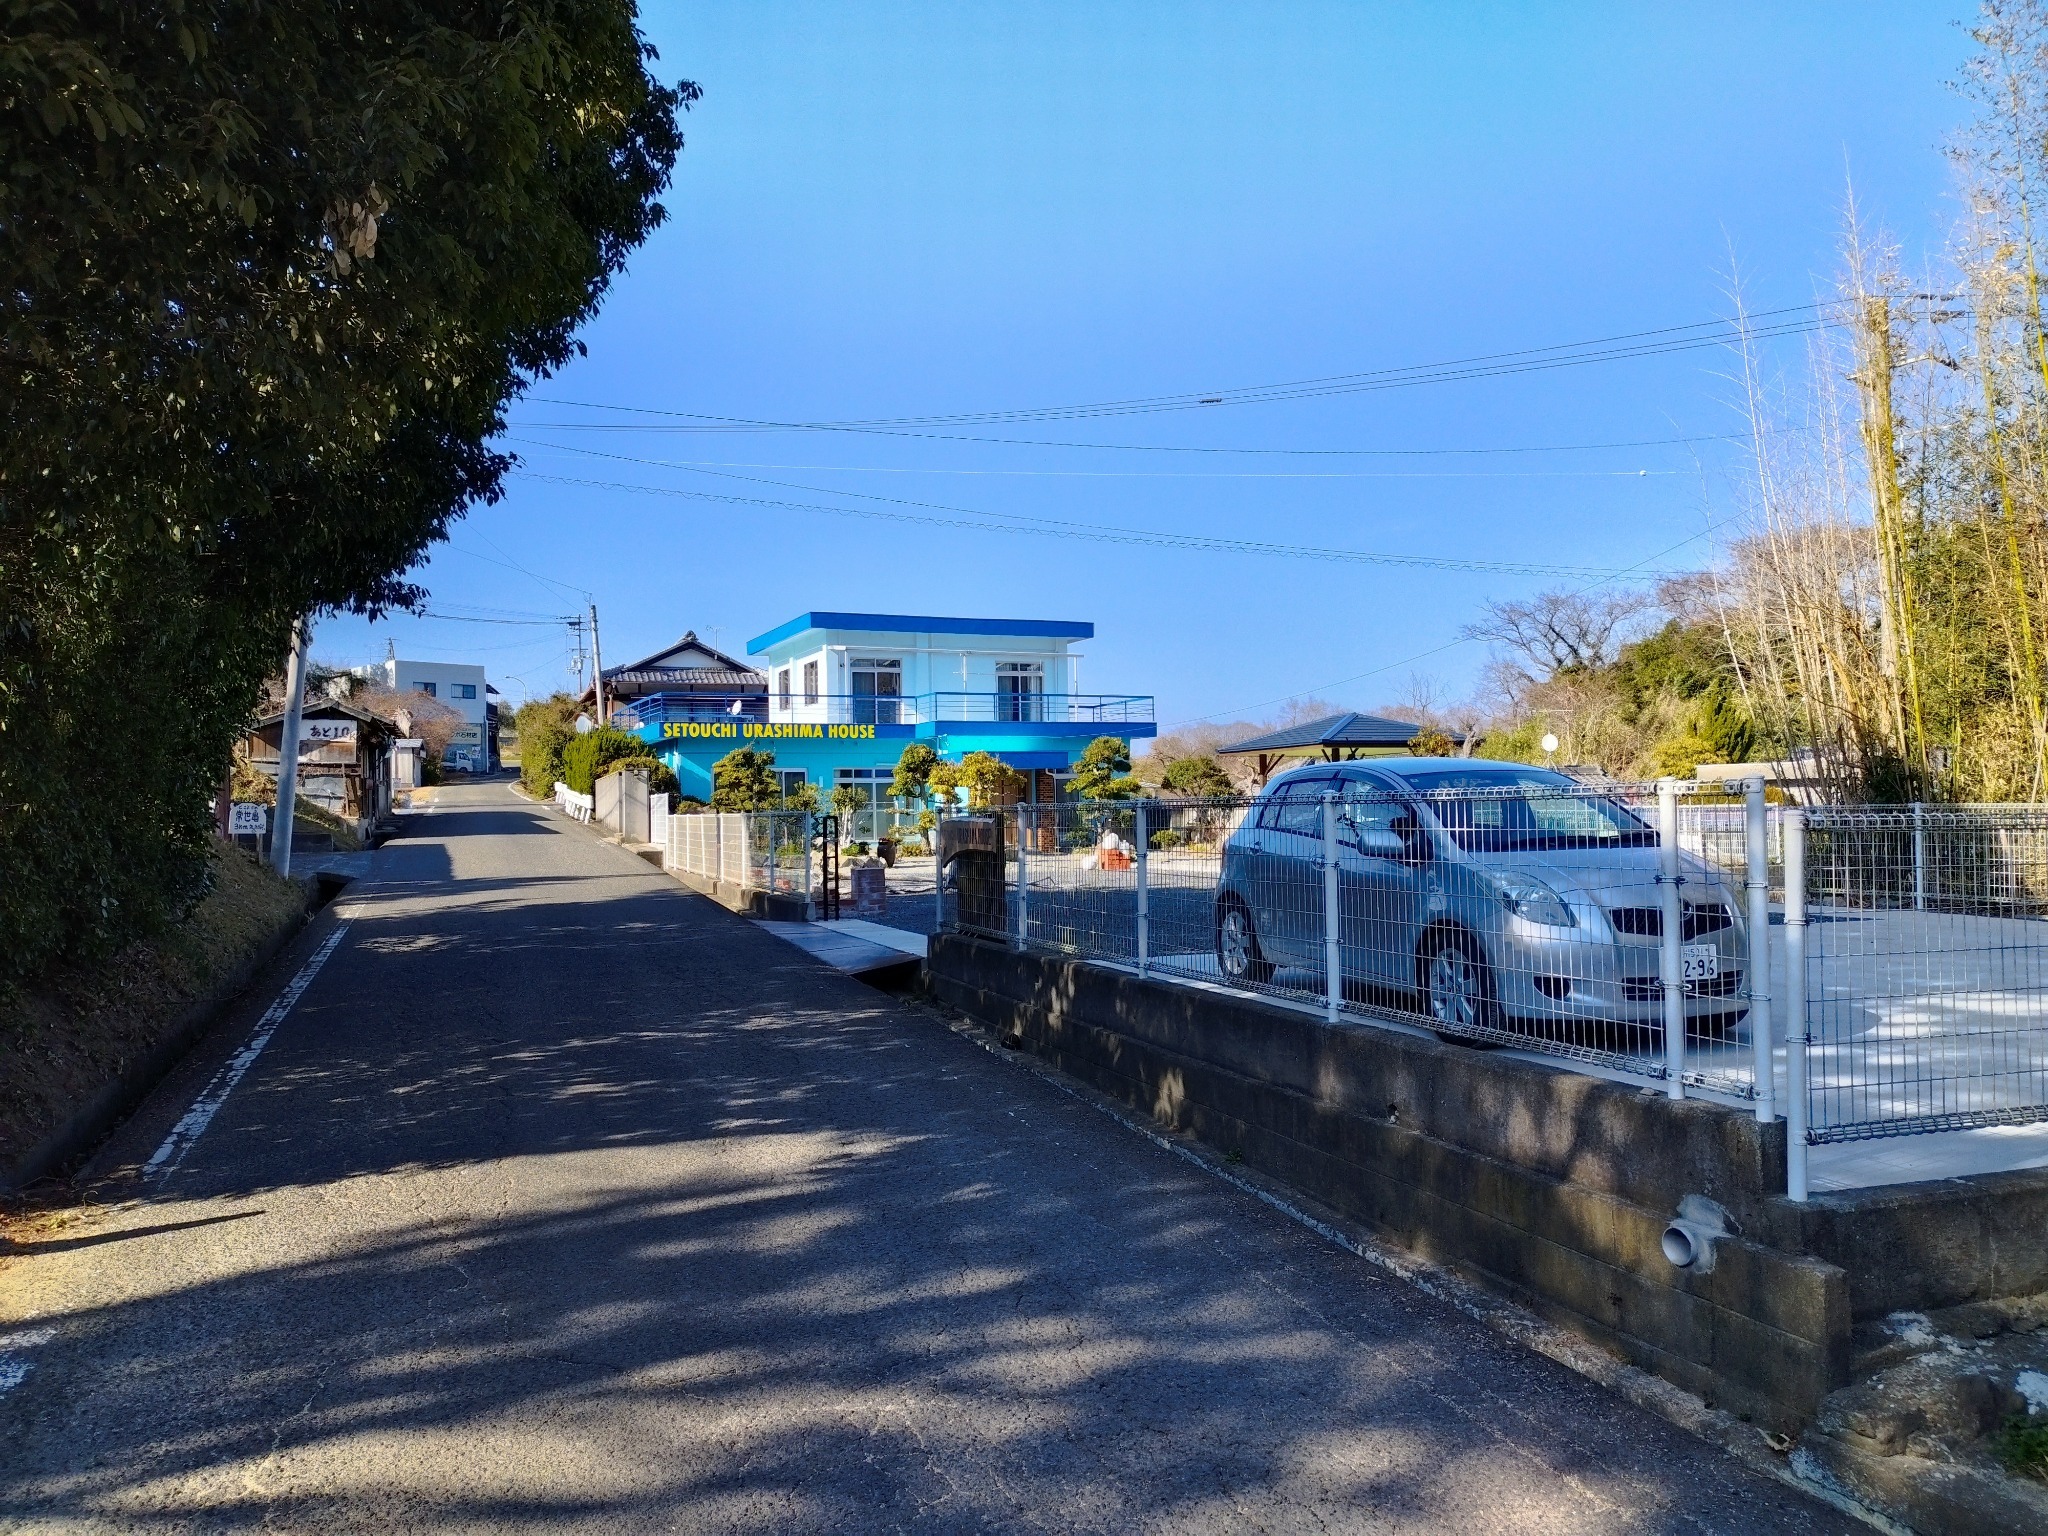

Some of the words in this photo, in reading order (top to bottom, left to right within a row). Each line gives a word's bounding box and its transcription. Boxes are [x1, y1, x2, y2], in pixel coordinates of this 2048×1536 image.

[663, 723, 737, 738] SETOUCHI
[743, 723, 824, 738] URASHIMA
[828, 724, 875, 739] HOUSE
[1684, 959, 1715, 978] 2-96
